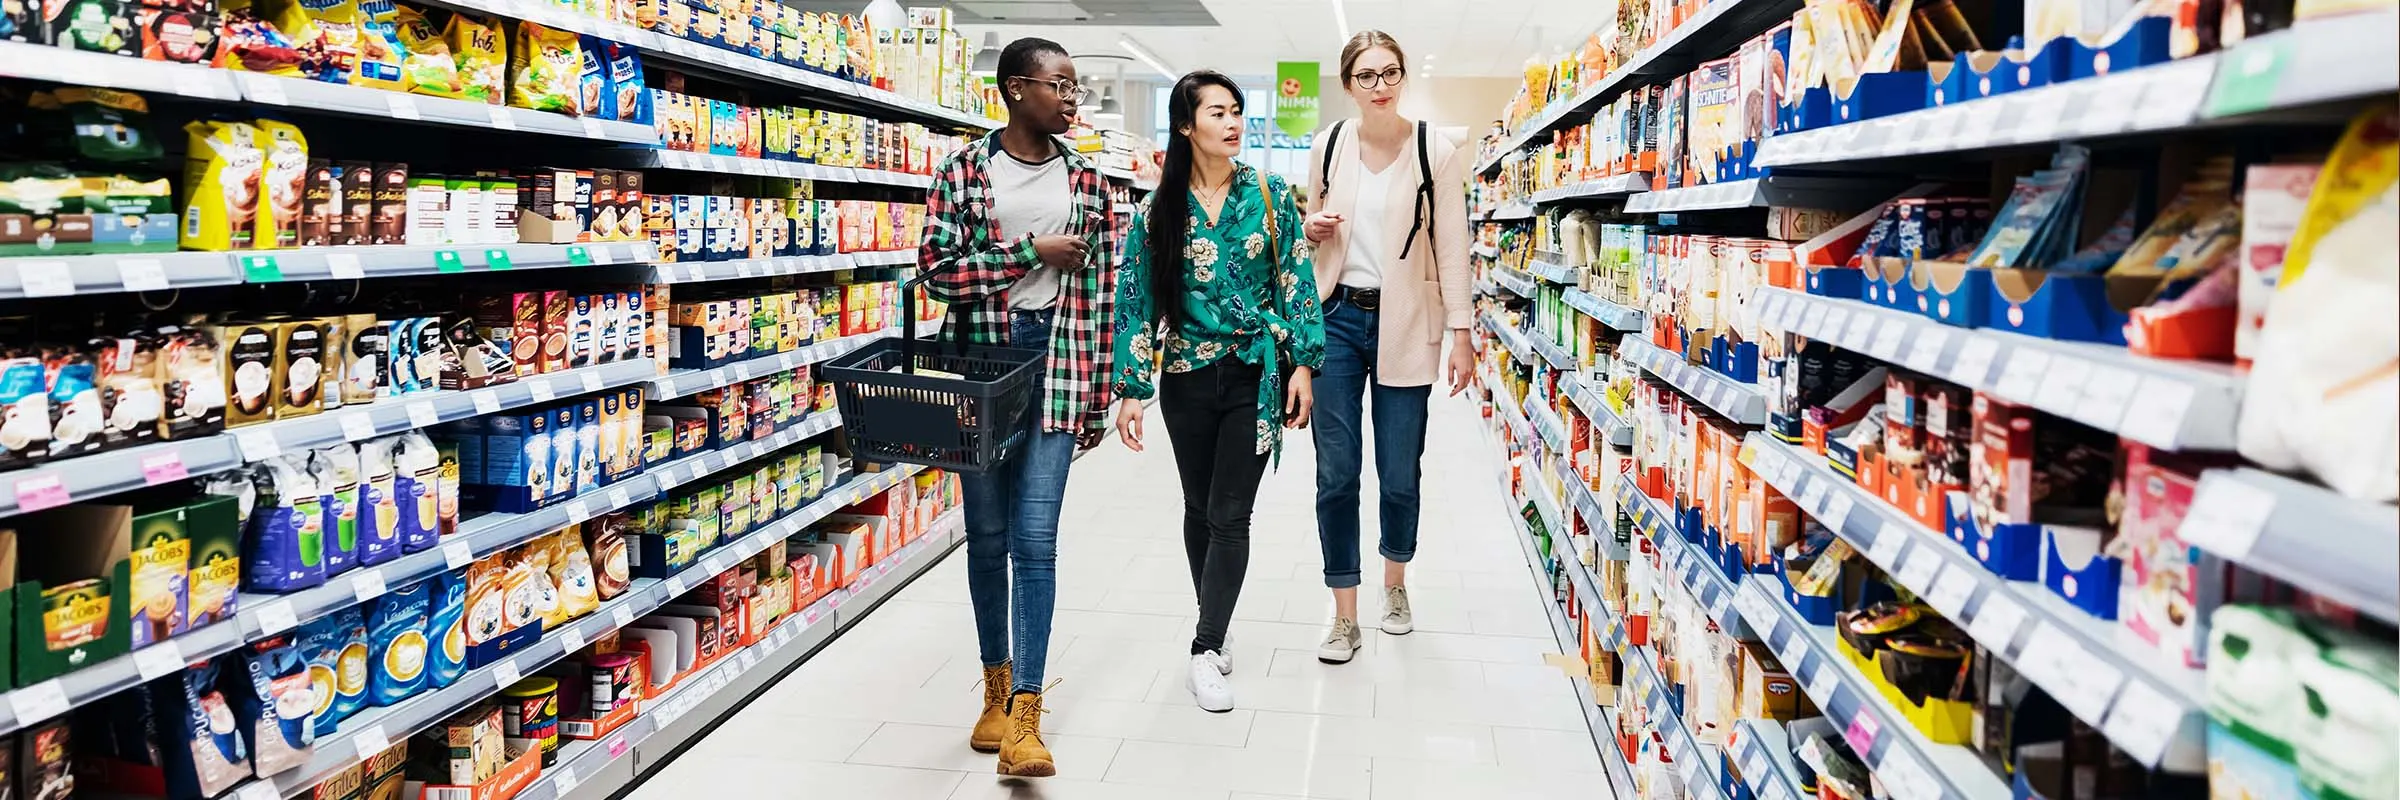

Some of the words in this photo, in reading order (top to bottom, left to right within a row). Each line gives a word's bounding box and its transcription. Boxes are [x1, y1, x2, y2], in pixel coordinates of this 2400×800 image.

[1278, 96, 1319, 108] NIMM
[137, 546, 184, 569] JACOBS
[194, 562, 237, 587] JACOBS
[54, 603, 103, 625] JACOBS
